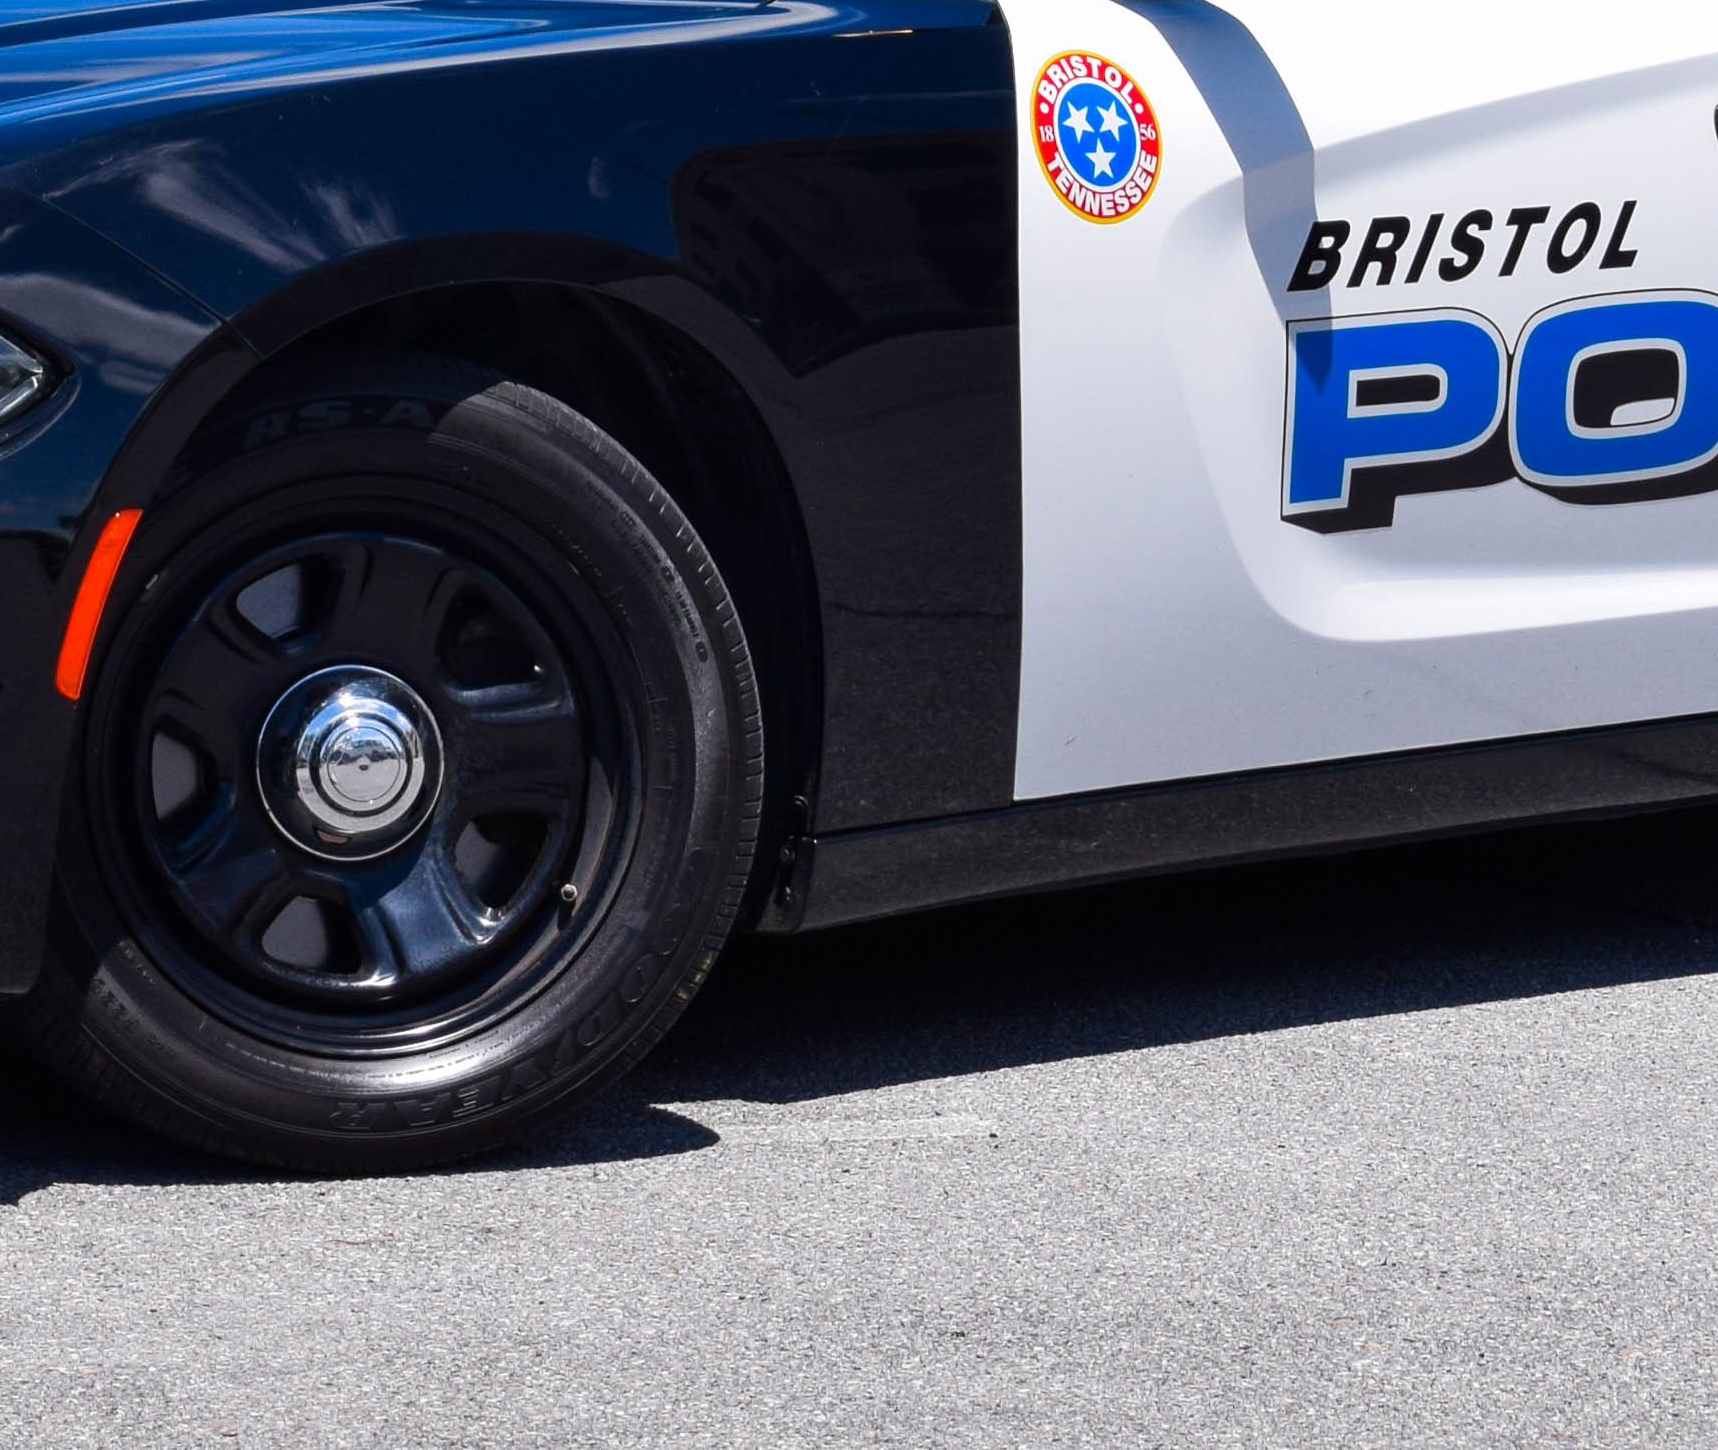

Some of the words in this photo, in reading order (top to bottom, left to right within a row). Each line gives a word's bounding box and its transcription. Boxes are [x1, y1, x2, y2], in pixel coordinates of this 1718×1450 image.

[1038, 55, 1135, 105] BRISTOL
[1039, 124, 1054, 142] 18
[1139, 123, 1156, 140] 56
[1047, 150, 1158, 217] TENNESSEE
[1287, 200, 1641, 292] BRISTOL
